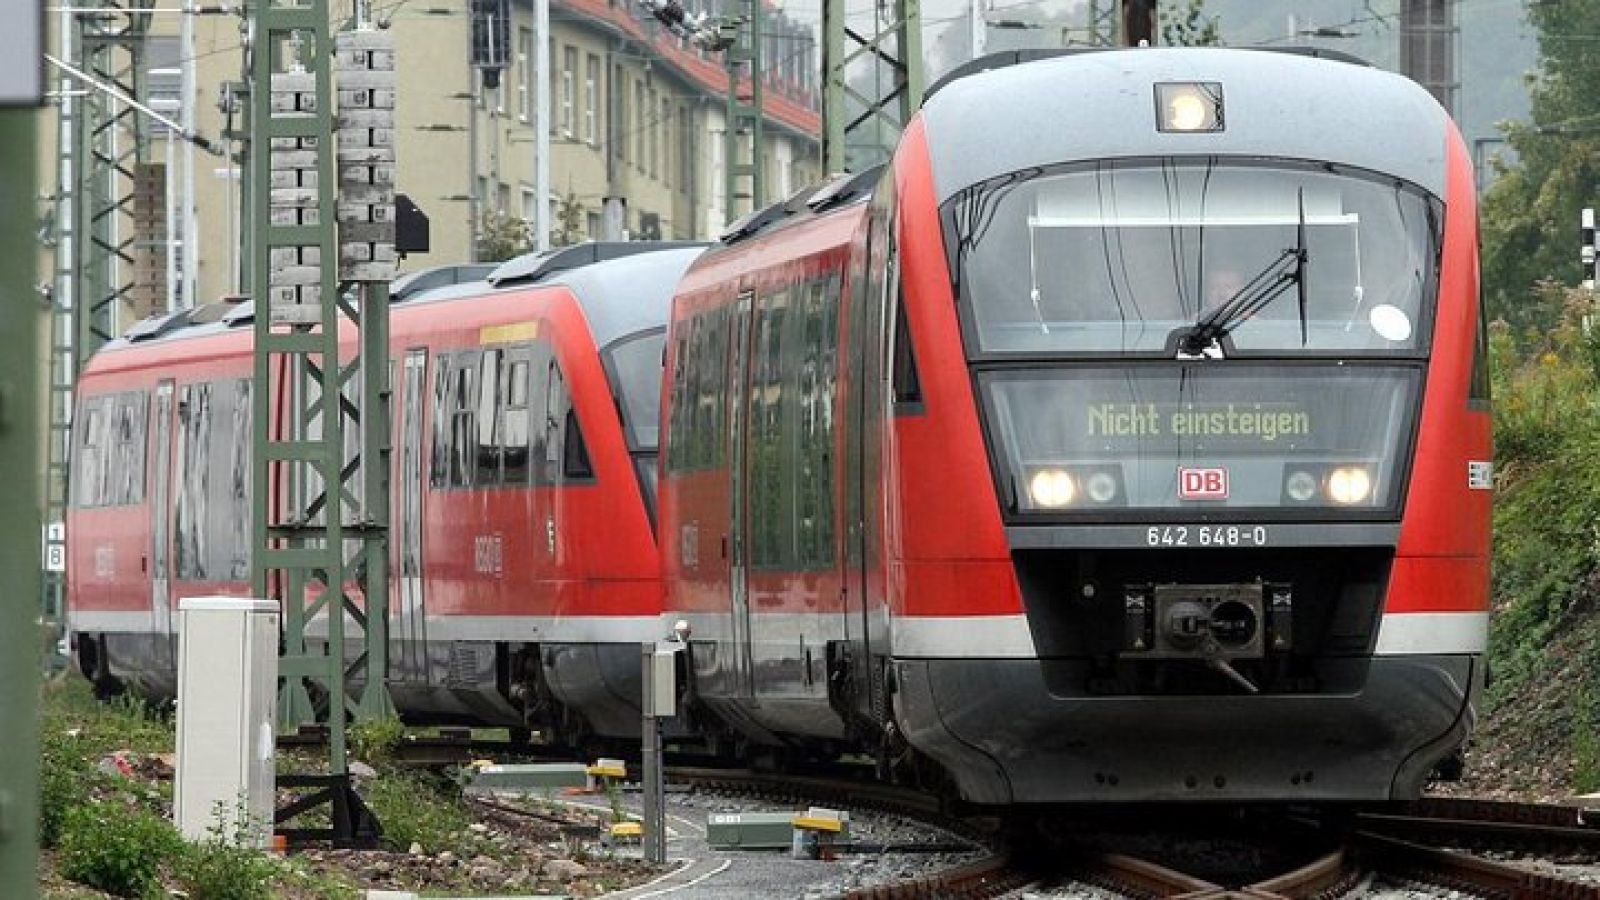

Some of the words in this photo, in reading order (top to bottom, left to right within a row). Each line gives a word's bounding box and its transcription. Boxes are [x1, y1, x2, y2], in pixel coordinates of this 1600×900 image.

[1087, 403, 1160, 436] Nicht
[1171, 403, 1309, 441] einsteigen
[1184, 470, 1223, 493] DB
[1147, 525, 1188, 546] 642
[1198, 525, 1267, 546] 648-0
